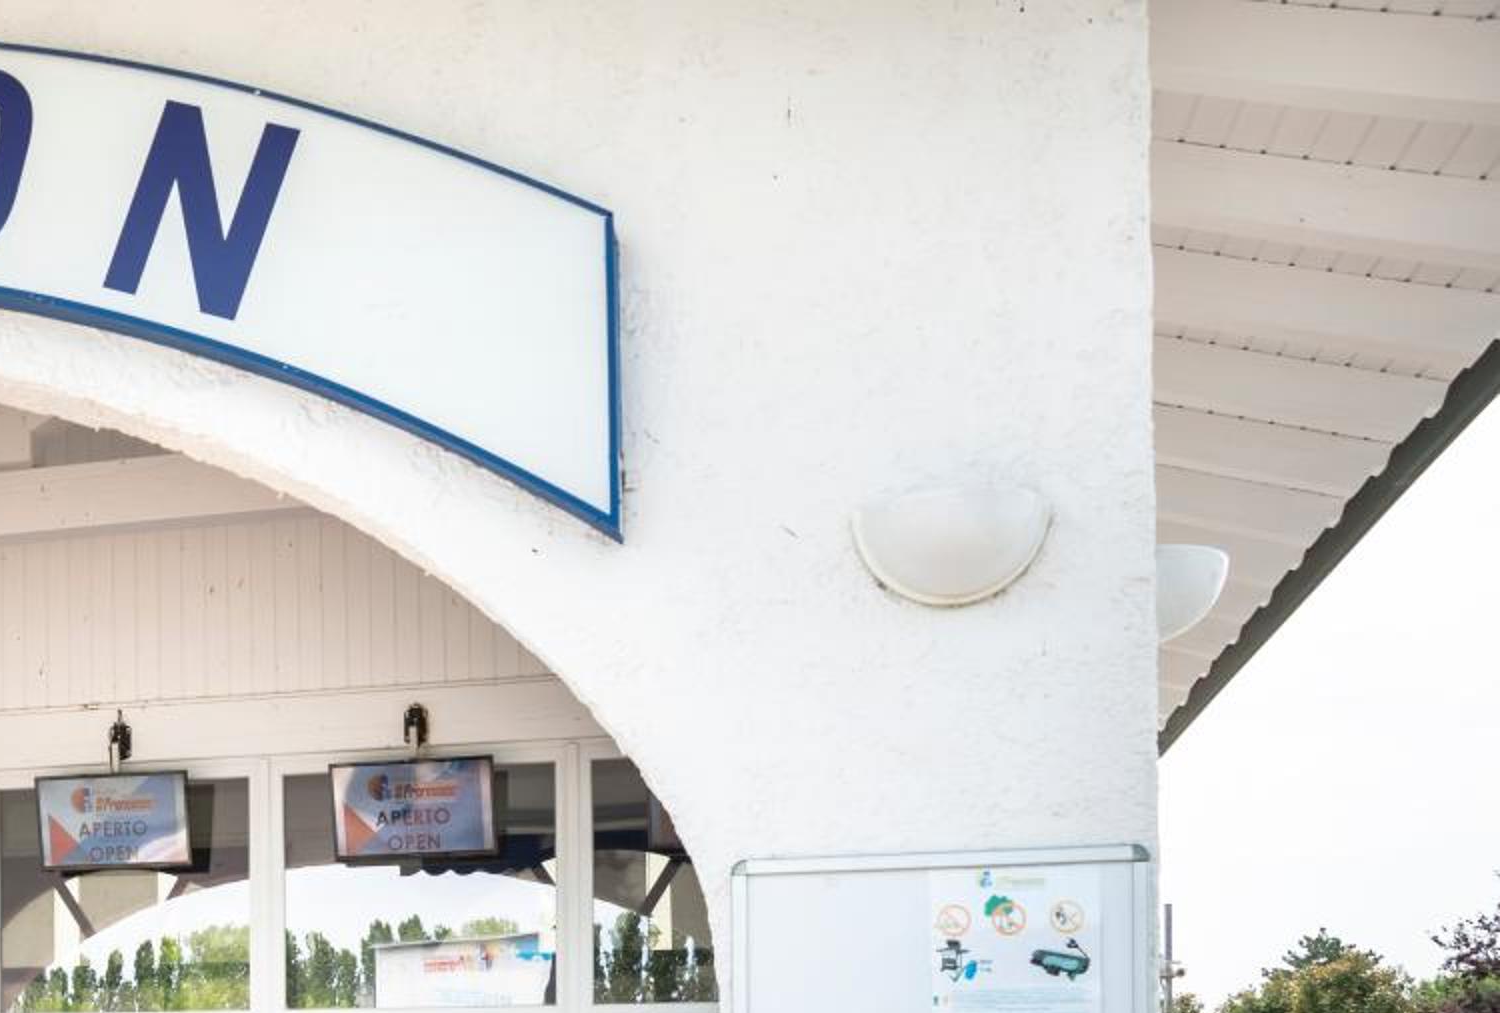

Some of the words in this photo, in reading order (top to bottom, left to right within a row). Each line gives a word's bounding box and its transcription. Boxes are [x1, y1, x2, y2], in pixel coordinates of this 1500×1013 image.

[376, 807, 450, 826] APERTO
[79, 820, 147, 837] APERTO
[388, 832, 441, 850] OPEN
[89, 846, 139, 861] OPEN
